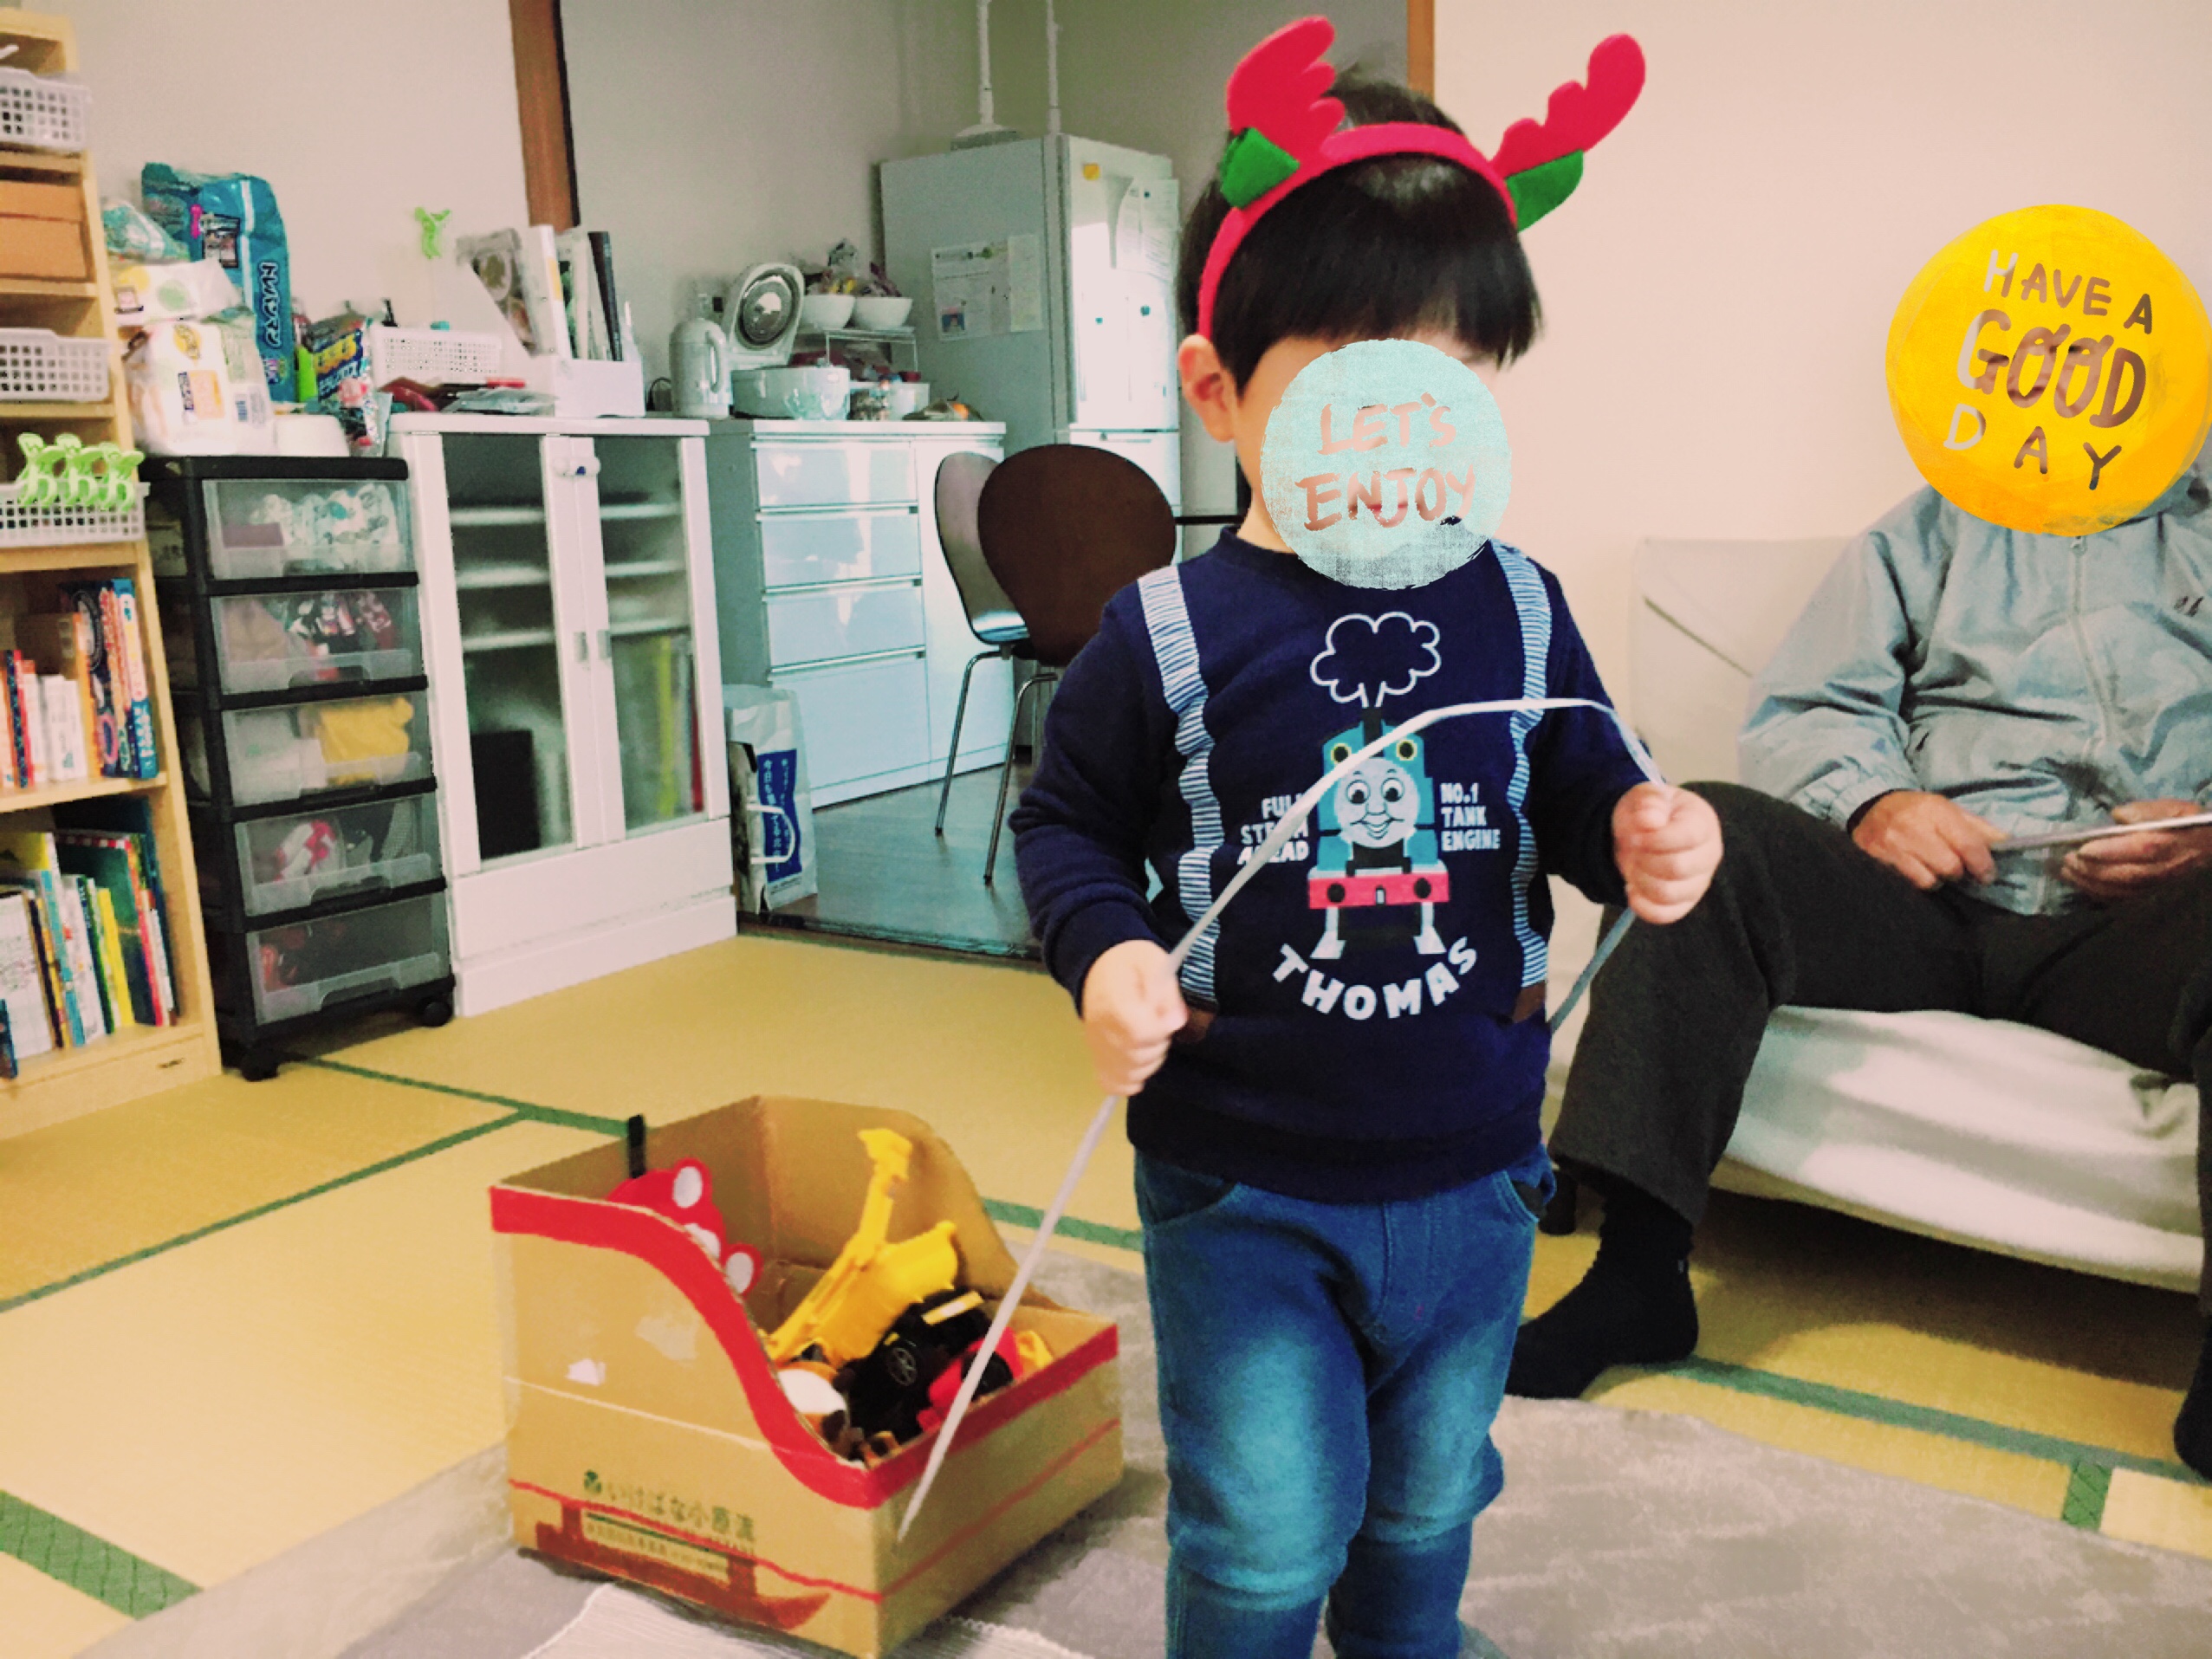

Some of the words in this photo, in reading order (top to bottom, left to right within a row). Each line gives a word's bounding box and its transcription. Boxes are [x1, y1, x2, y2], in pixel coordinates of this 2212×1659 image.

[1440, 782, 1479, 804] NO.1
[1262, 793, 1307, 820] FU
[1440, 806, 1487, 827] TANK
[1441, 828, 1501, 852] ENGINE
[1272, 936, 1477, 1021] THOMAS
